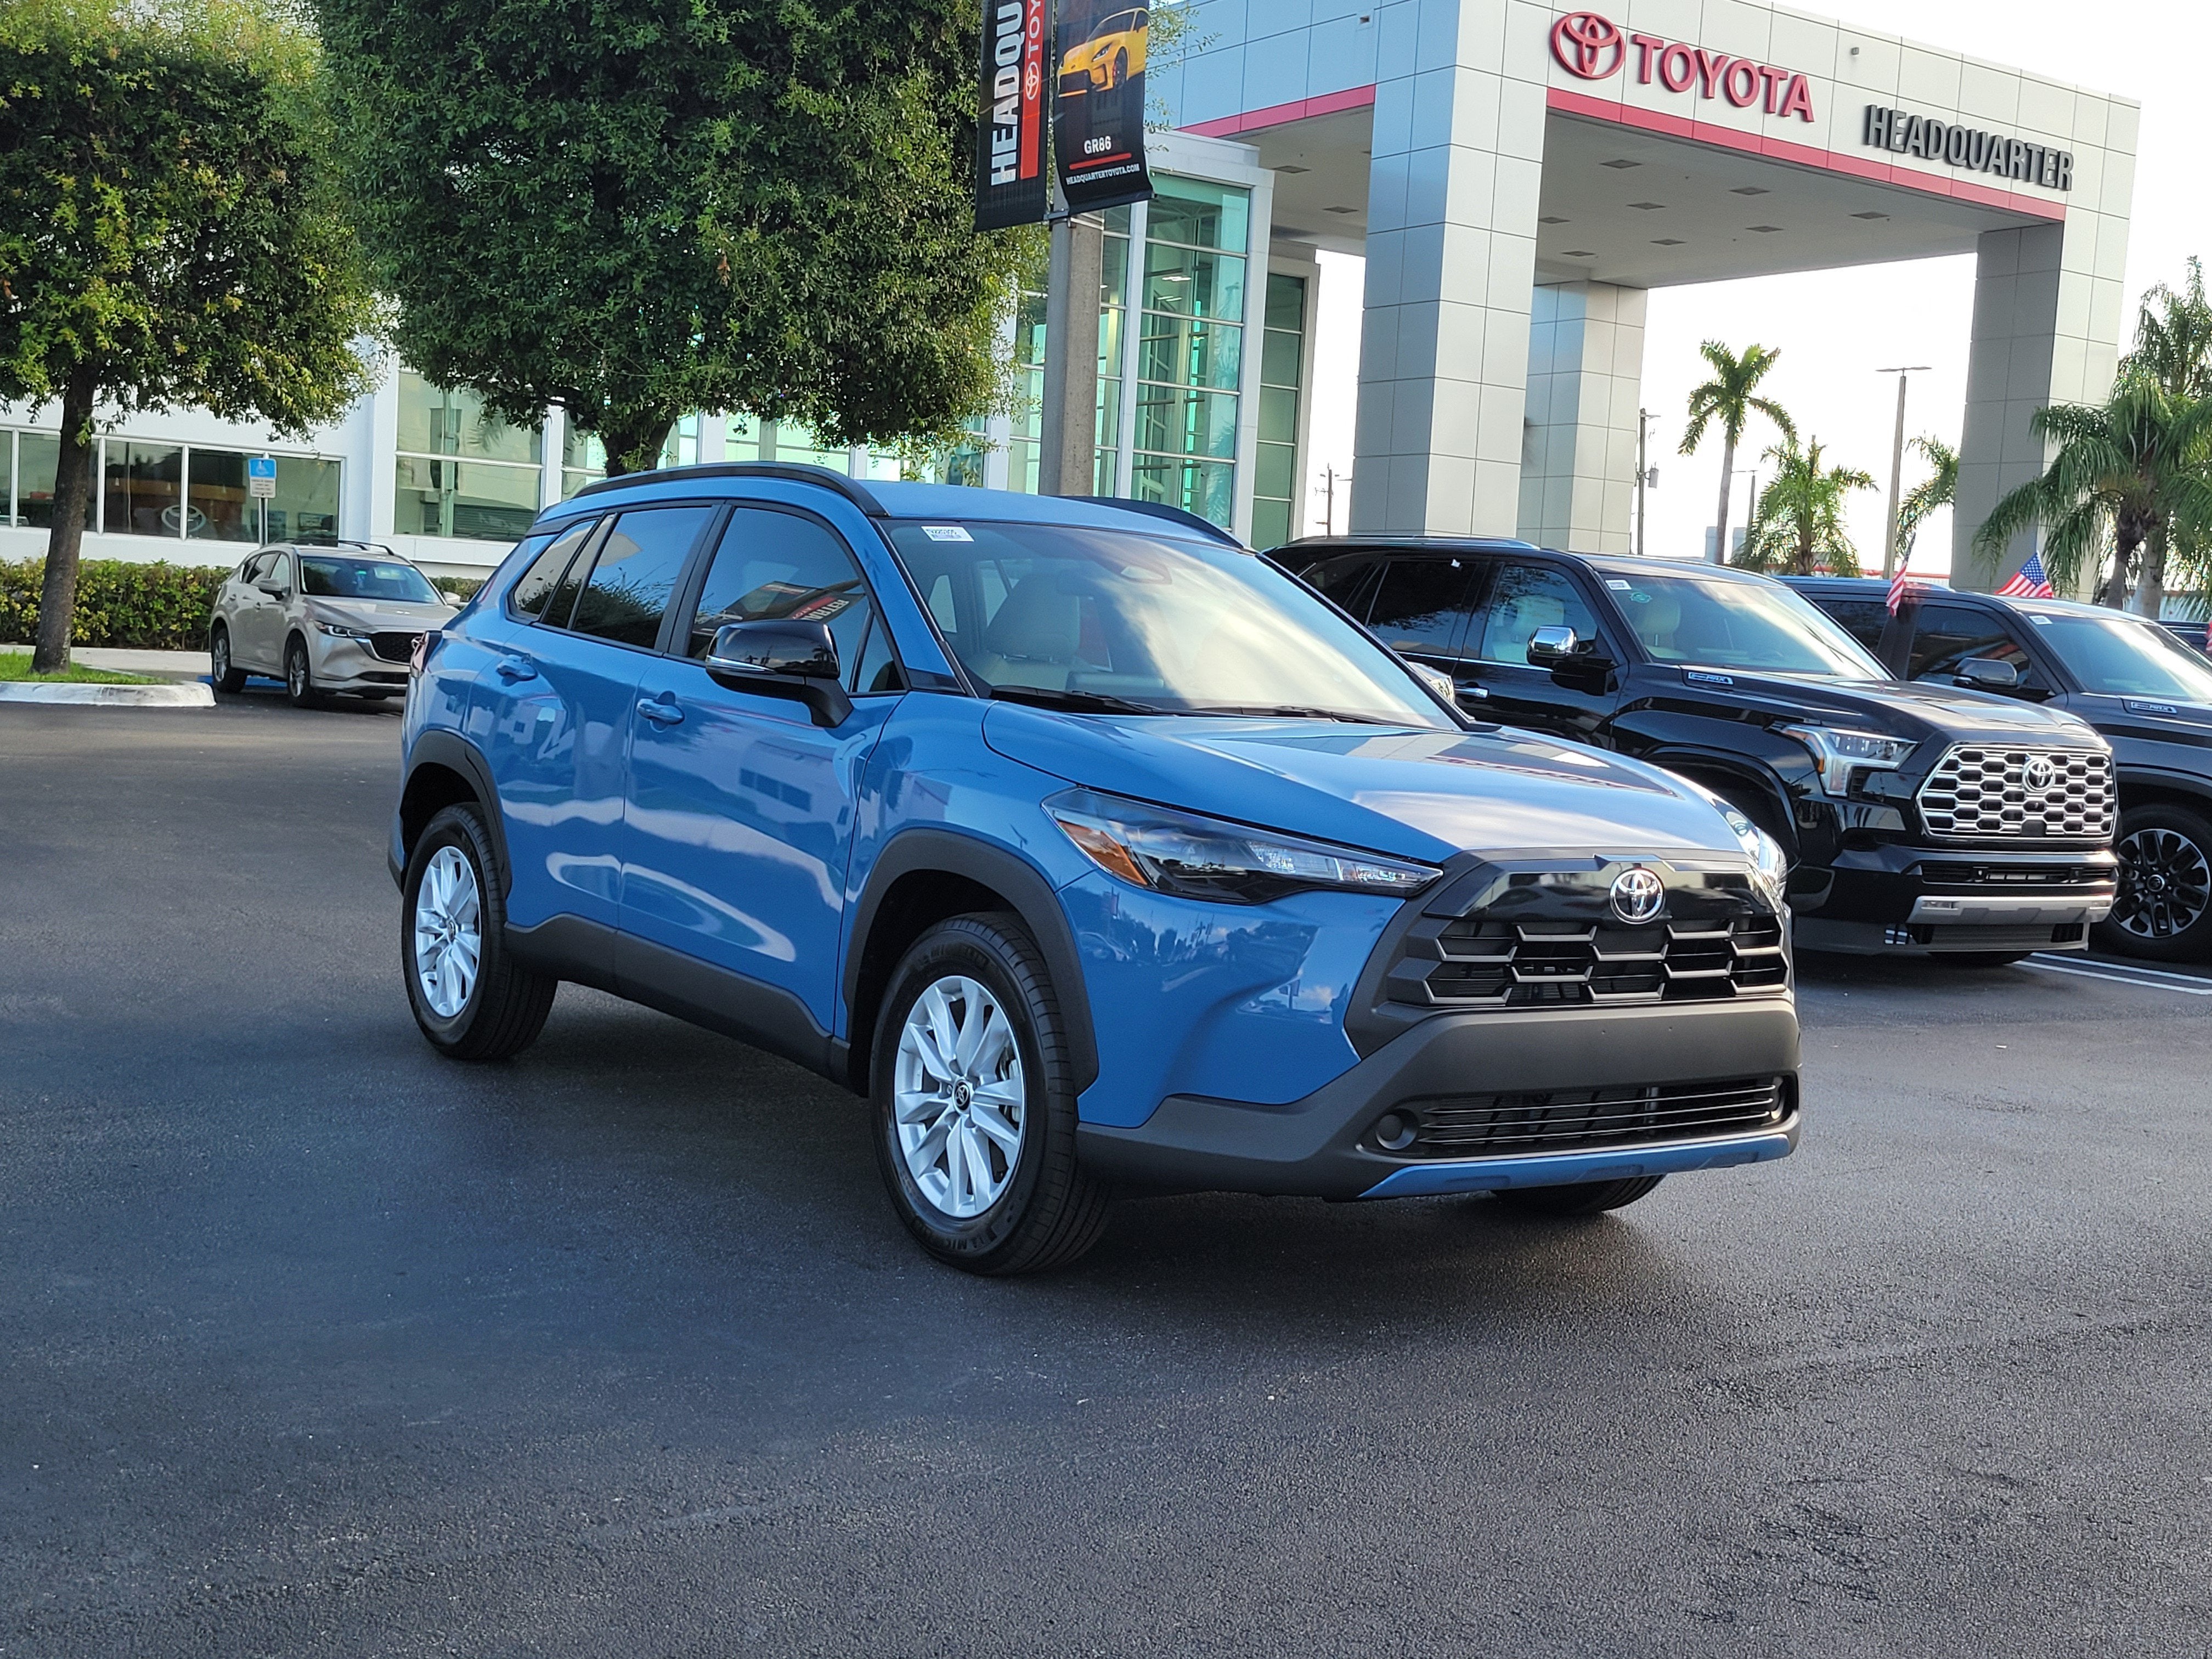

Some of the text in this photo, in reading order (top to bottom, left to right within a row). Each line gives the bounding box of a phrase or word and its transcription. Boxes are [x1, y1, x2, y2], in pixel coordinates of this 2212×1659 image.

[991, 2, 1025, 185] HEADQU
[1632, 33, 1814, 122] TOYOTA
[1065, 163, 1141, 185] HEADQUARTERTOYOTA.COM
[1084, 136, 1112, 154] GR86
[1865, 104, 2074, 191] HEADQUARTER
